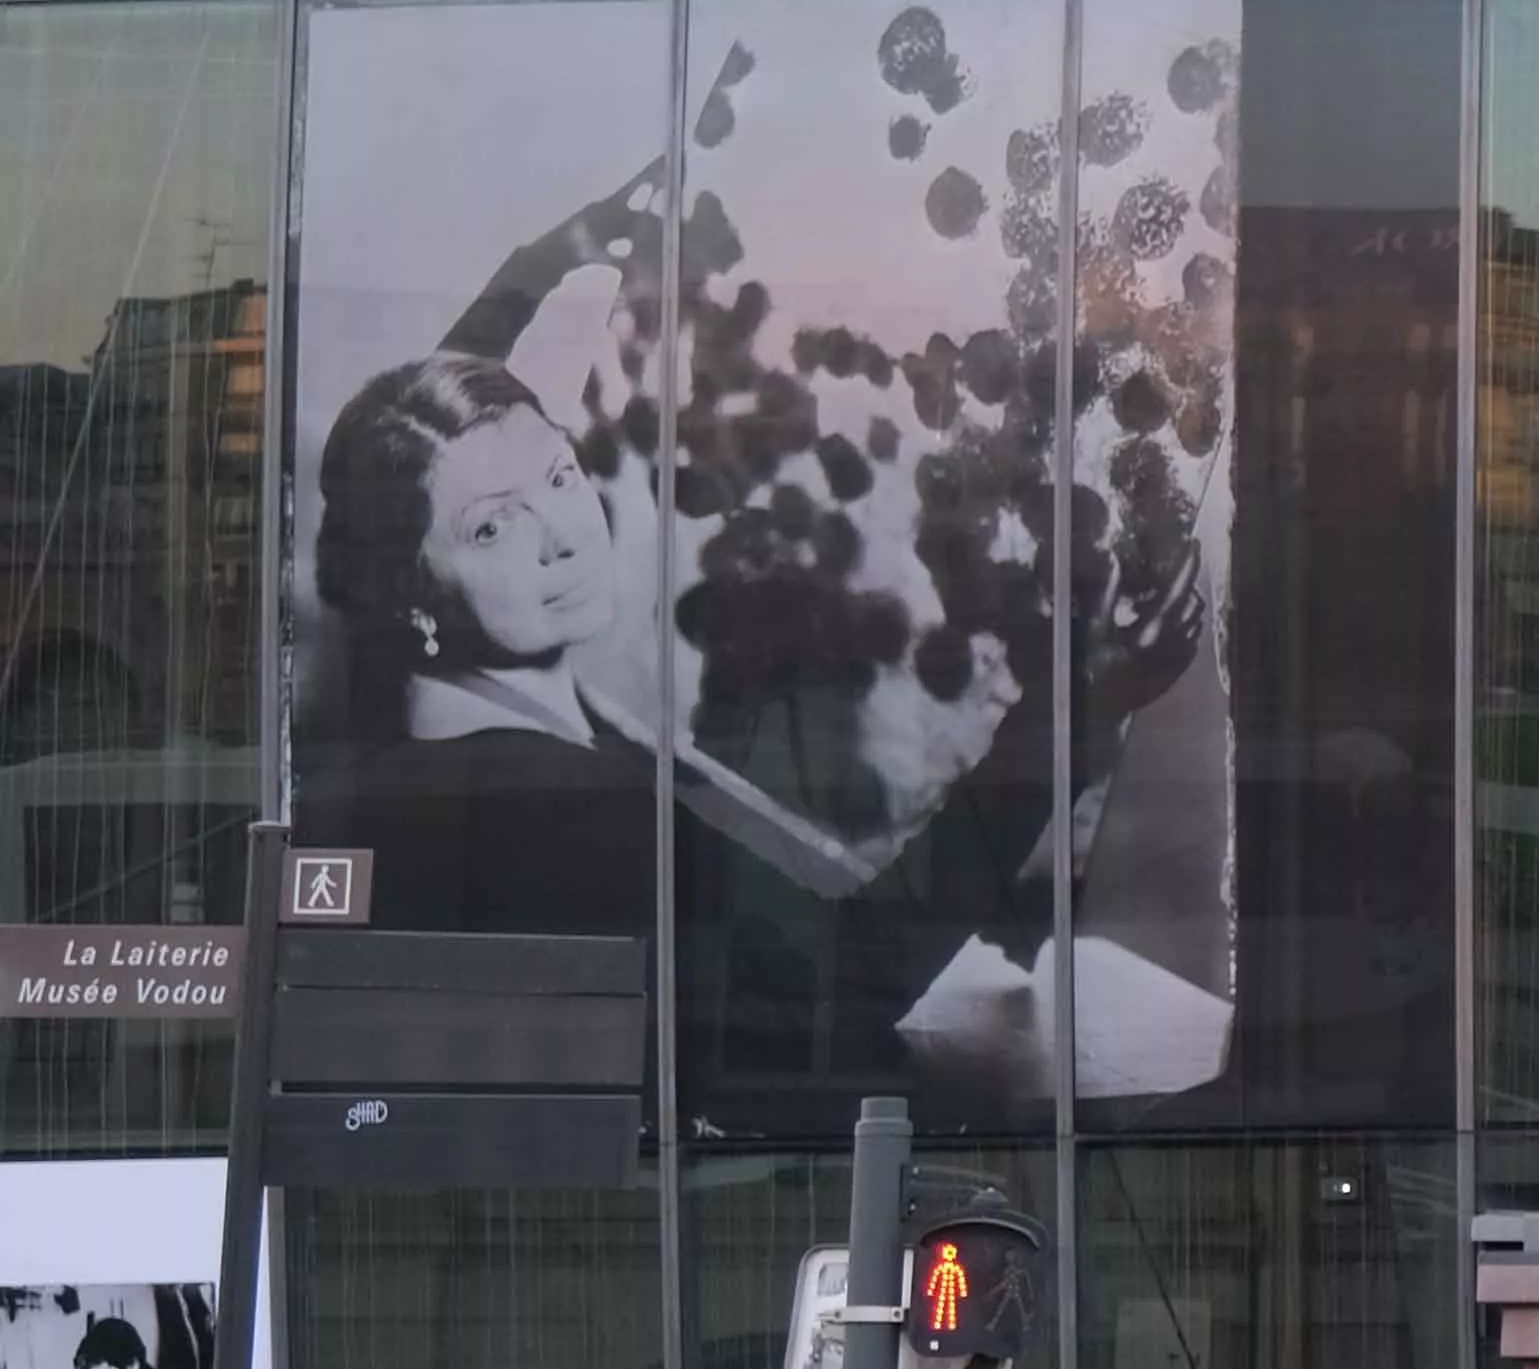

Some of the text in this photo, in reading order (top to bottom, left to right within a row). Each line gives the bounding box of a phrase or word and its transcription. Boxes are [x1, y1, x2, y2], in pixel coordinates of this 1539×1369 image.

[63, 939, 229, 967] La Laiterie
[17, 977, 227, 1005] Musée Vodou
